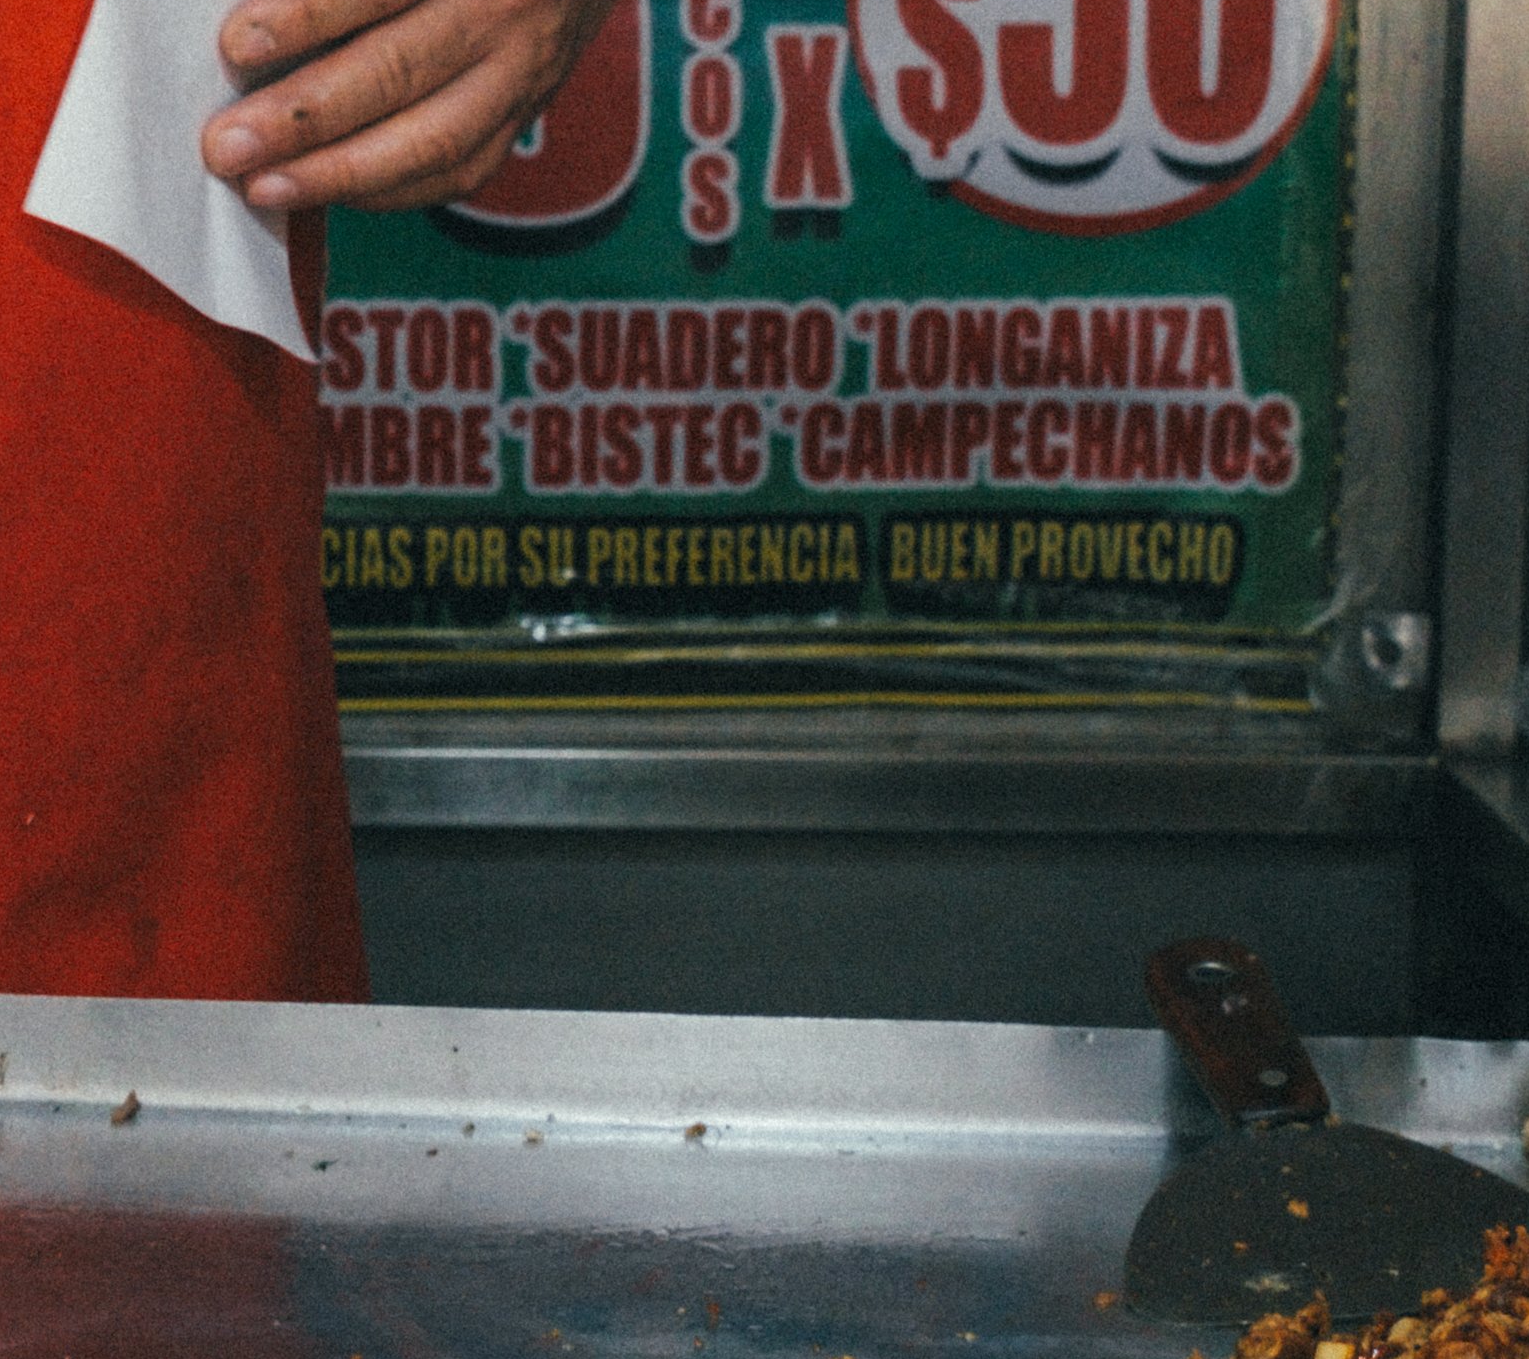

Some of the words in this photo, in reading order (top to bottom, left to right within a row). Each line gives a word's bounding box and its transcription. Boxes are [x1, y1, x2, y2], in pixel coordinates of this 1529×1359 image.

[764, 23, 852, 208] X
[323, 305, 494, 392] STOR
[532, 305, 838, 392] SUADERO
[872, 304, 1237, 391] LONGANIZA
[320, 403, 494, 488] MBRE
[529, 402, 762, 488] BISTEC
[799, 399, 1296, 487] CAMPECHANOS
[321, 526, 413, 587] CIAS
[426, 526, 508, 587] POR
[518, 525, 575, 587] SU
[587, 523, 860, 587] PREFERENCIA
[890, 522, 1000, 583] BUEN
[1011, 521, 1236, 584] PROVECHO
